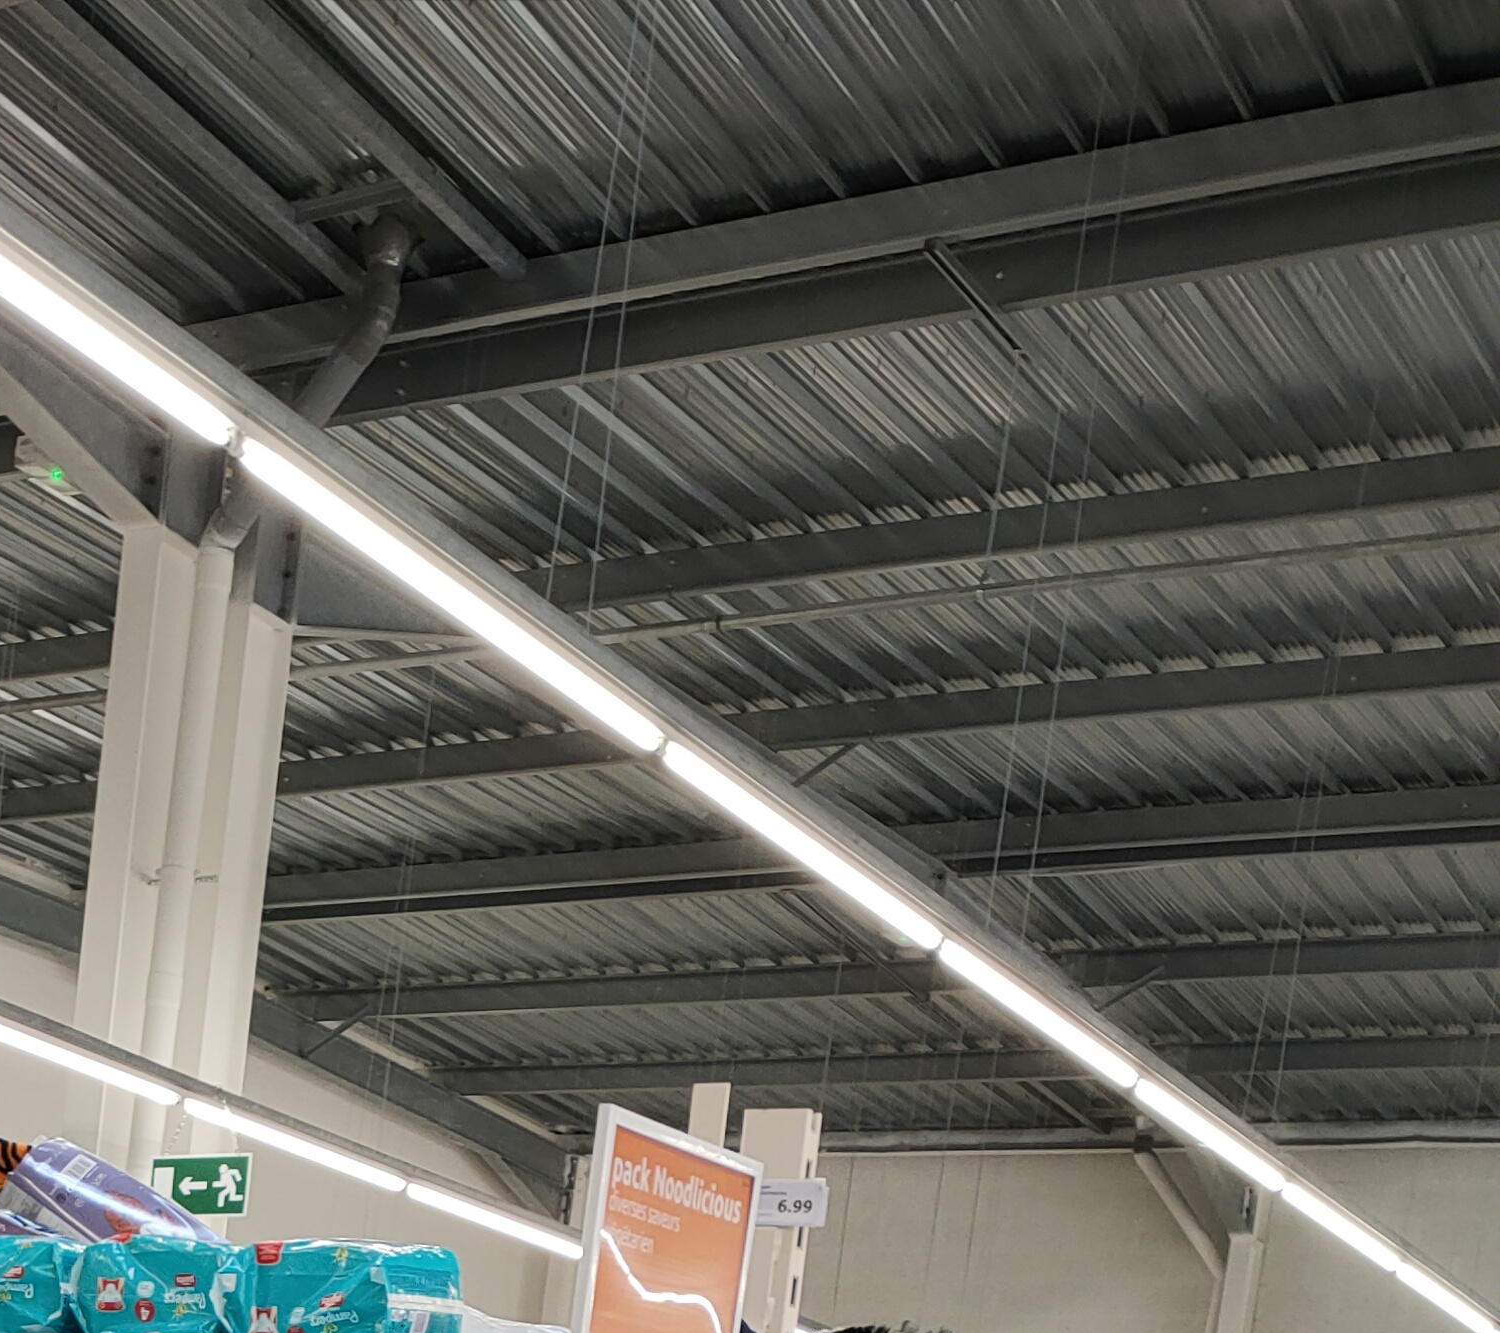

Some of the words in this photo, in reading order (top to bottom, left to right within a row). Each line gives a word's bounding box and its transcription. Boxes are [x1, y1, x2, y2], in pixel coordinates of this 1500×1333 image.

[611, 1156, 652, 1193] pack
[652, 1164, 742, 1224] Noodlicious
[776, 1198, 814, 1215] 6.99
